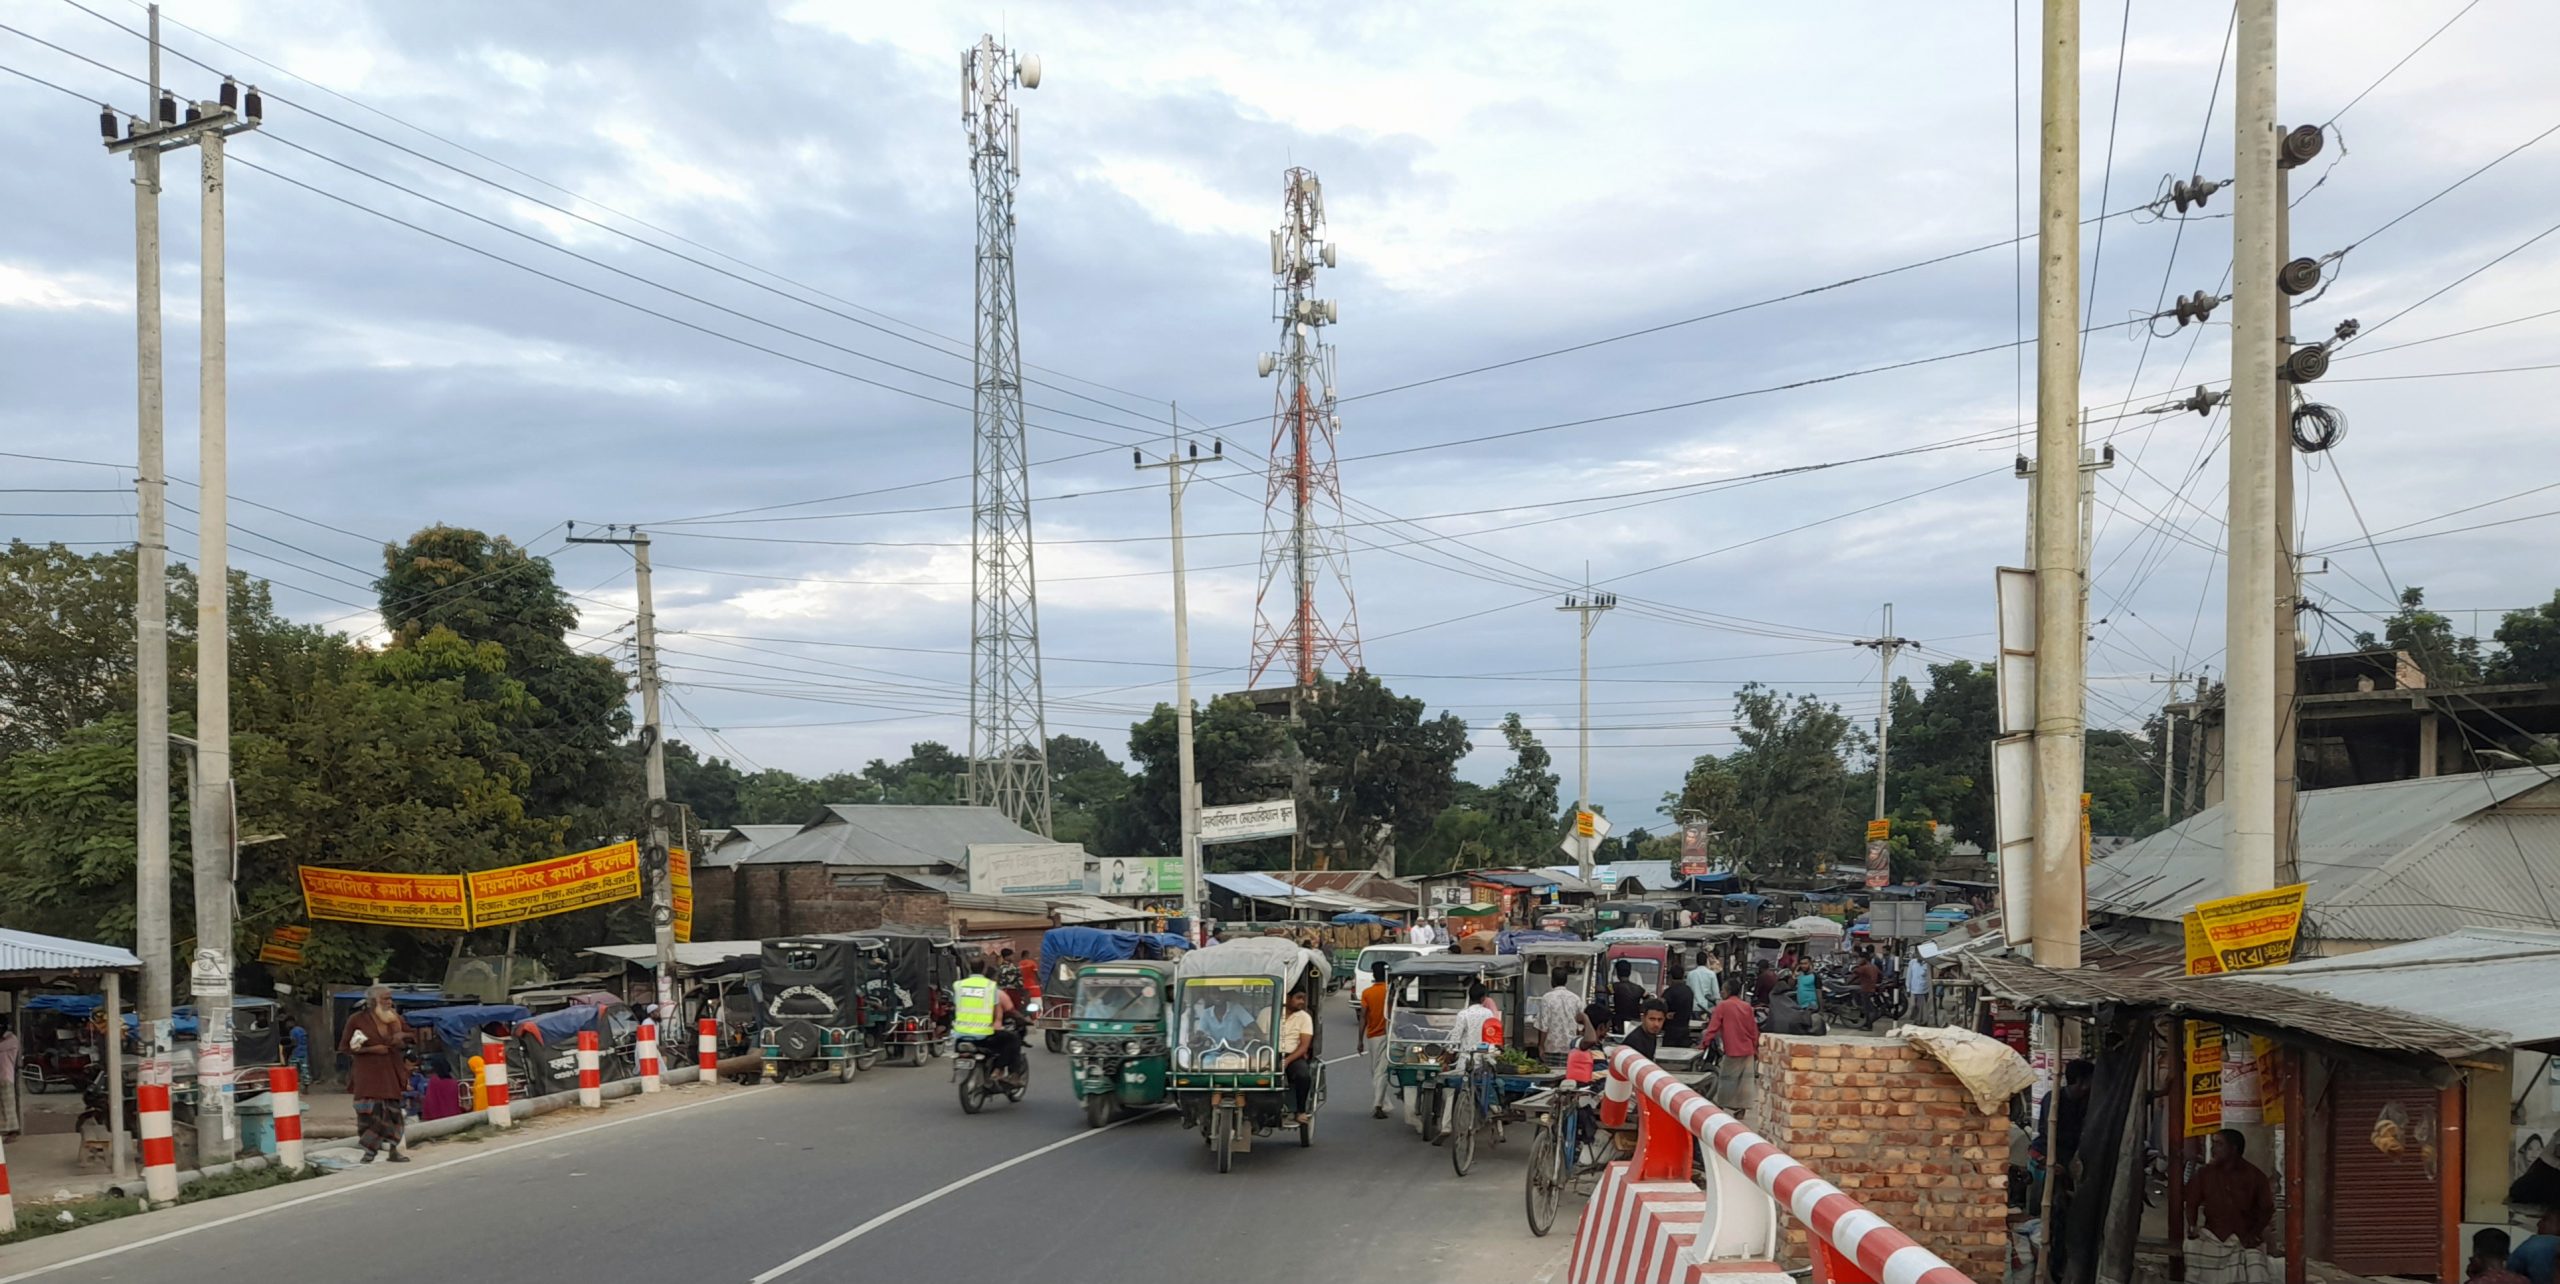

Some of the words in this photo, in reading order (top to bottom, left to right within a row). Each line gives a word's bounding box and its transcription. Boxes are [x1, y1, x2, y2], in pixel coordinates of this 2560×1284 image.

[477, 870, 547, 894] ময়মনসিংহ
[549, 858, 587, 881] কমার্স
[589, 853, 632, 874] কলেজ
[374, 880, 413, 899] কমার্স
[415, 884, 458, 900] কলেজ
